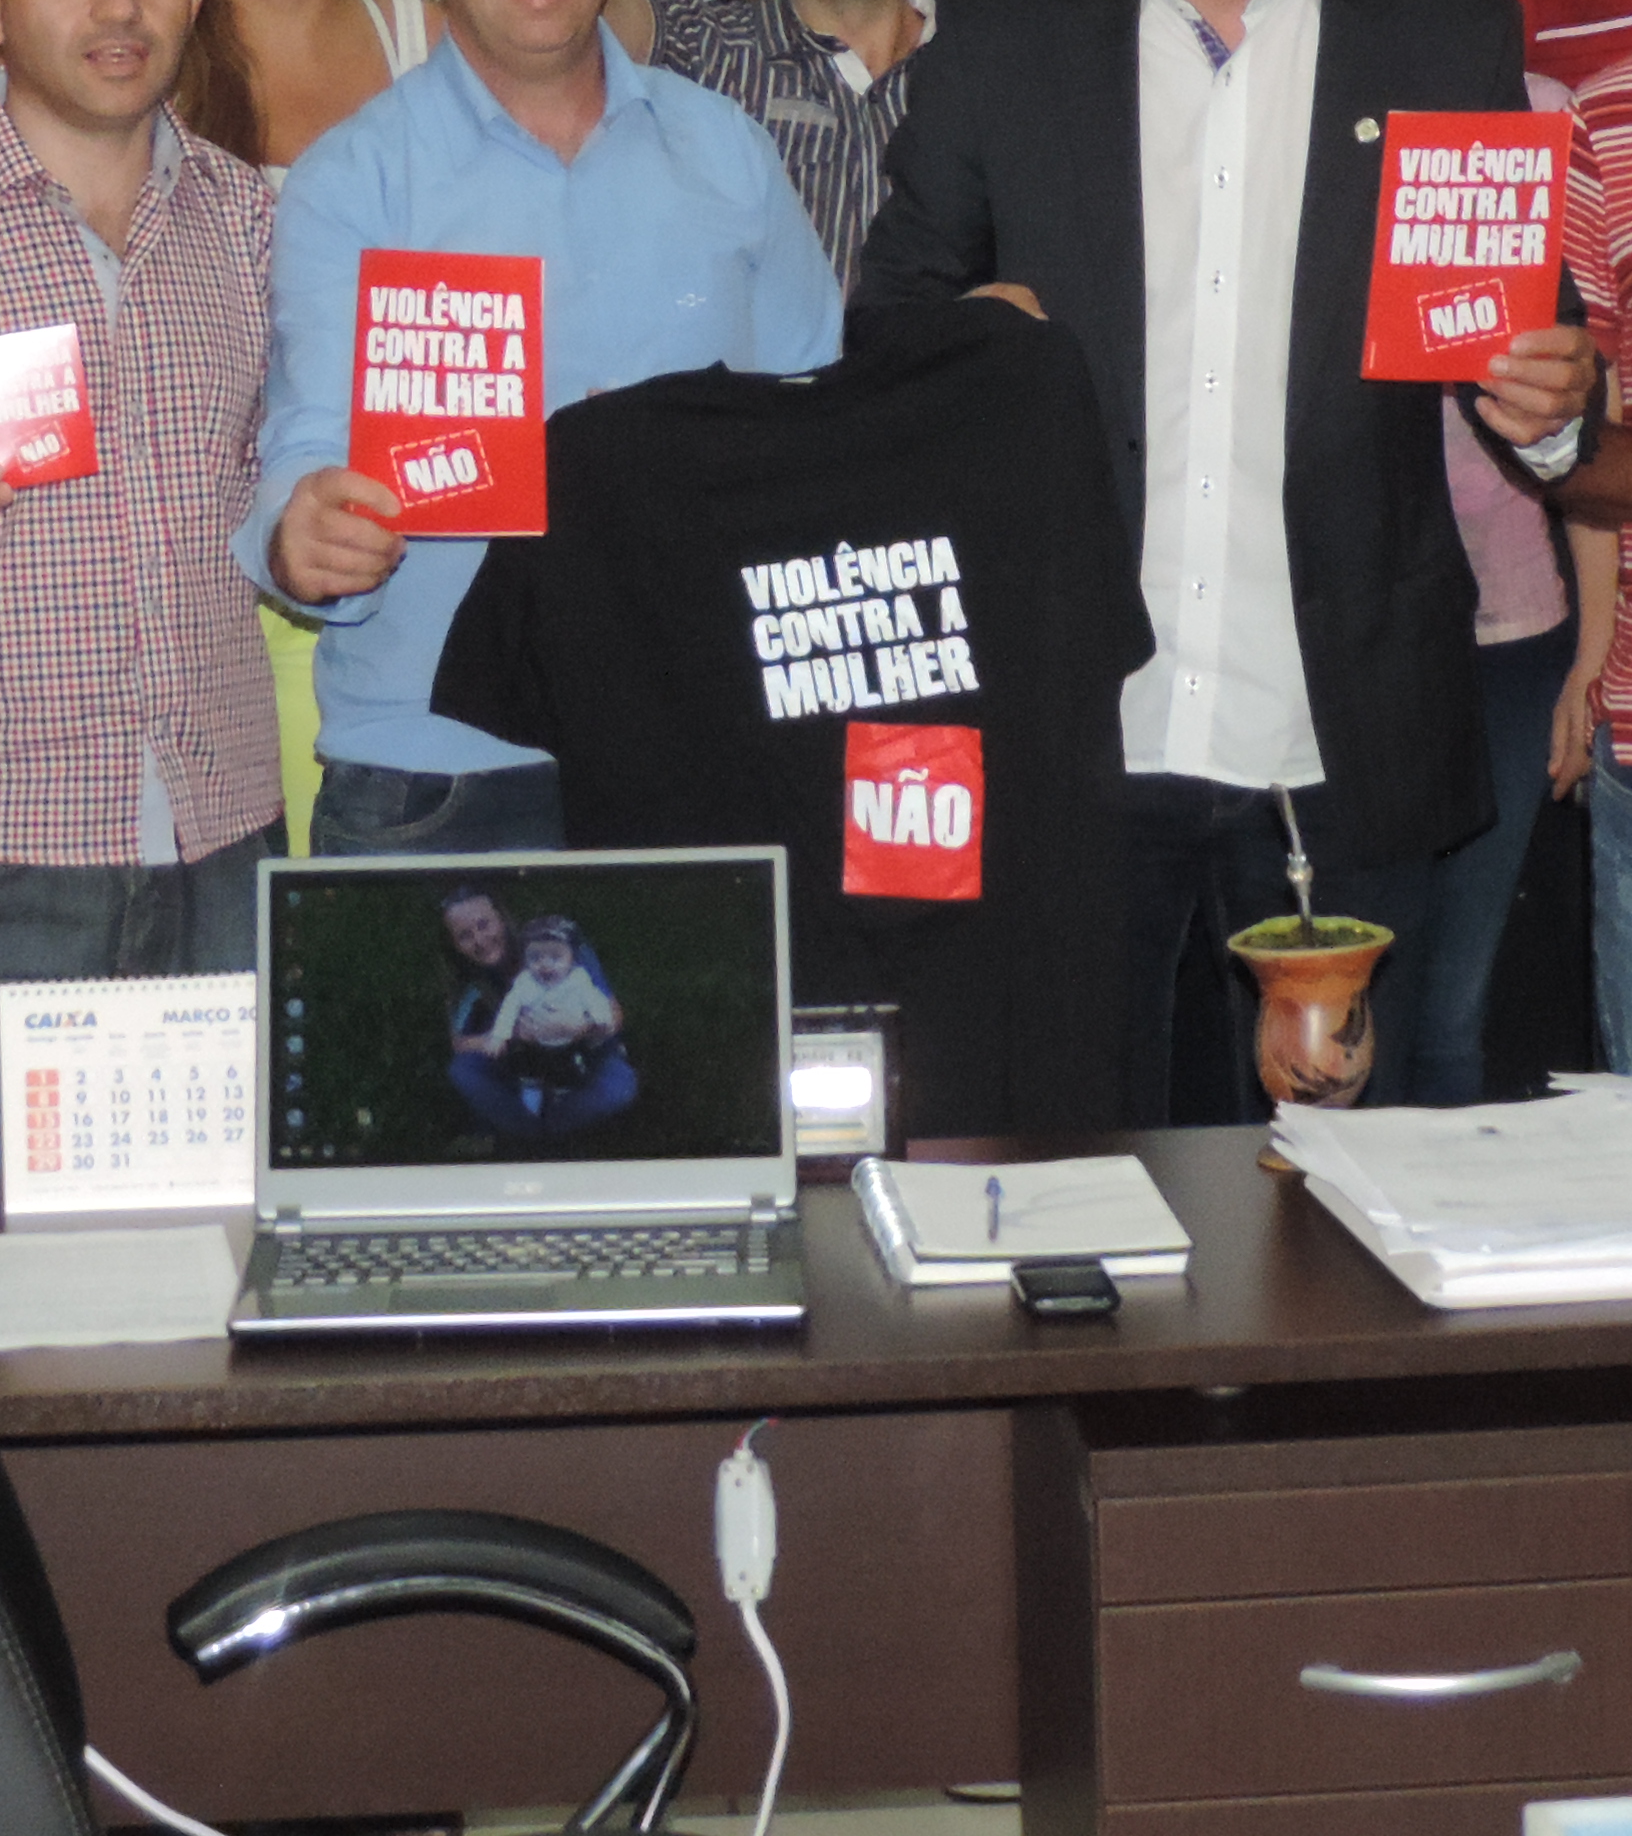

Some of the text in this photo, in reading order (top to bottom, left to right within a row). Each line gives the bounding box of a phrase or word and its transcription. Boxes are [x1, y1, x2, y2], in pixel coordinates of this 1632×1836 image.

[1401, 143, 1551, 183] VIOLÊNCIA
[1395, 186, 1549, 220] CONTRA A
[1391, 224, 1544, 265] MULHER
[371, 284, 524, 329] VIOLÊNCIA
[1430, 295, 1496, 337] NÃO
[367, 327, 524, 370] CONTRA A
[64, 366, 76, 385] A
[365, 368, 523, 416] MULHER
[405, 446, 477, 492] NÃO
[741, 536, 960, 610] VIOLÊNCIA
[753, 586, 968, 662] CONTRA A
[762, 636, 980, 719] MULHER
[852, 767, 971, 849] NÃO
[25, 1011, 97, 1029] CAIXA
[163, 1007, 230, 1026] MARÇO
